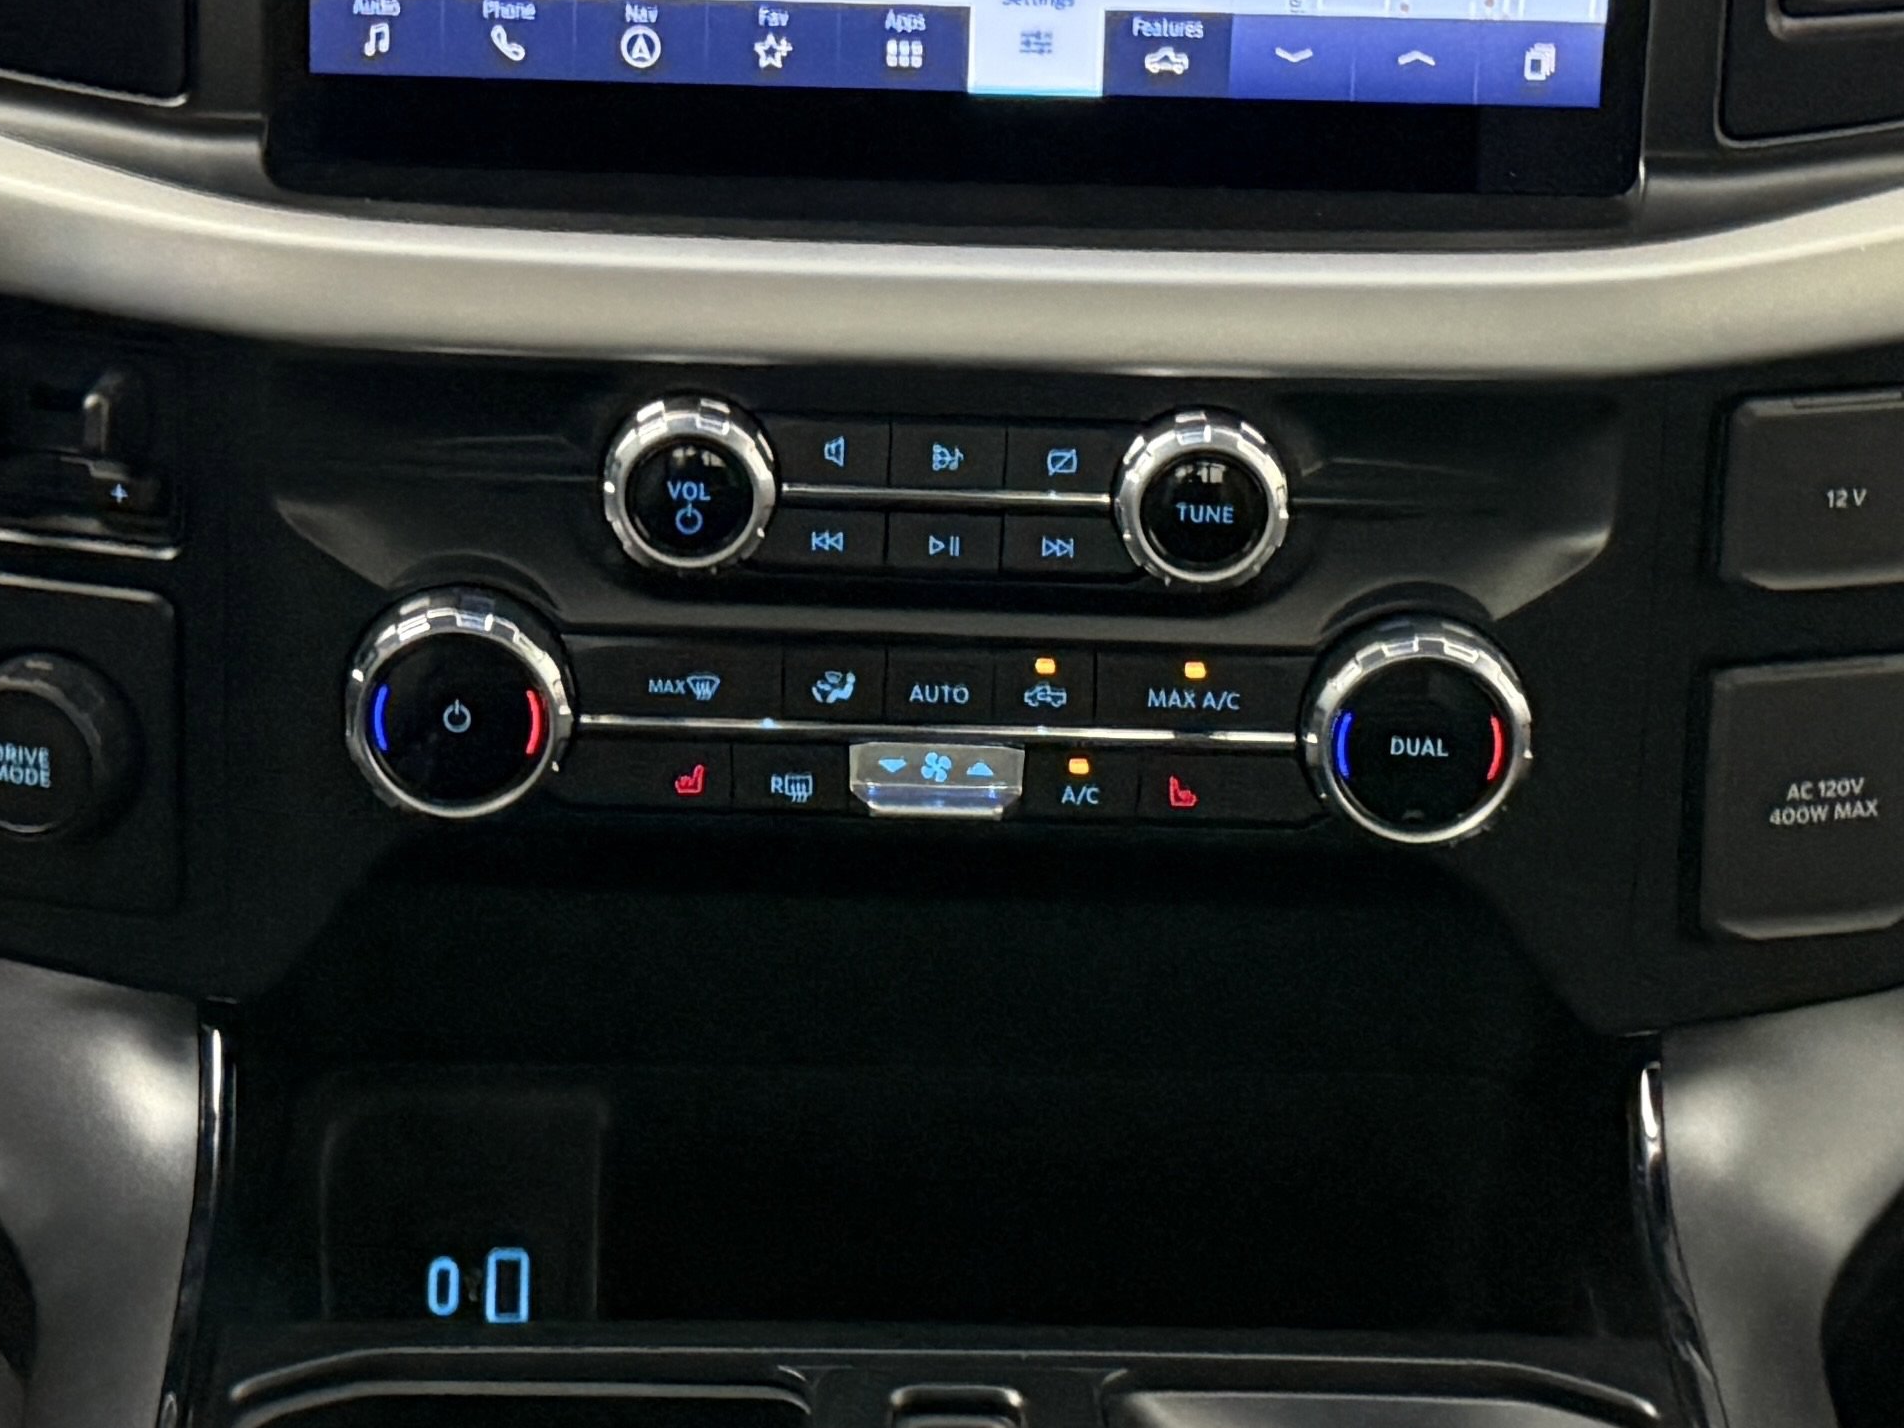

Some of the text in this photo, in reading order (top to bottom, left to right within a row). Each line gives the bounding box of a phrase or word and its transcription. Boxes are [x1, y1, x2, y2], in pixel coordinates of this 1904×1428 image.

[624, 2, 659, 25] Nav
[757, 5, 790, 29] Fav
[883, 8, 927, 35] Apps
[1131, 16, 1204, 41] Features
[666, 480, 712, 503] VOL
[1825, 488, 1868, 509] 12 V
[1175, 500, 1235, 526] TUNE
[647, 678, 687, 696] MAX
[908, 682, 970, 706] AUTO
[1147, 687, 1241, 712] MAX A/C
[1389, 734, 1450, 759] DUAL
[1060, 782, 1100, 806] A/C
[1785, 776, 1866, 802] AC 120V
[1768, 798, 1879, 827] 400W MAX
